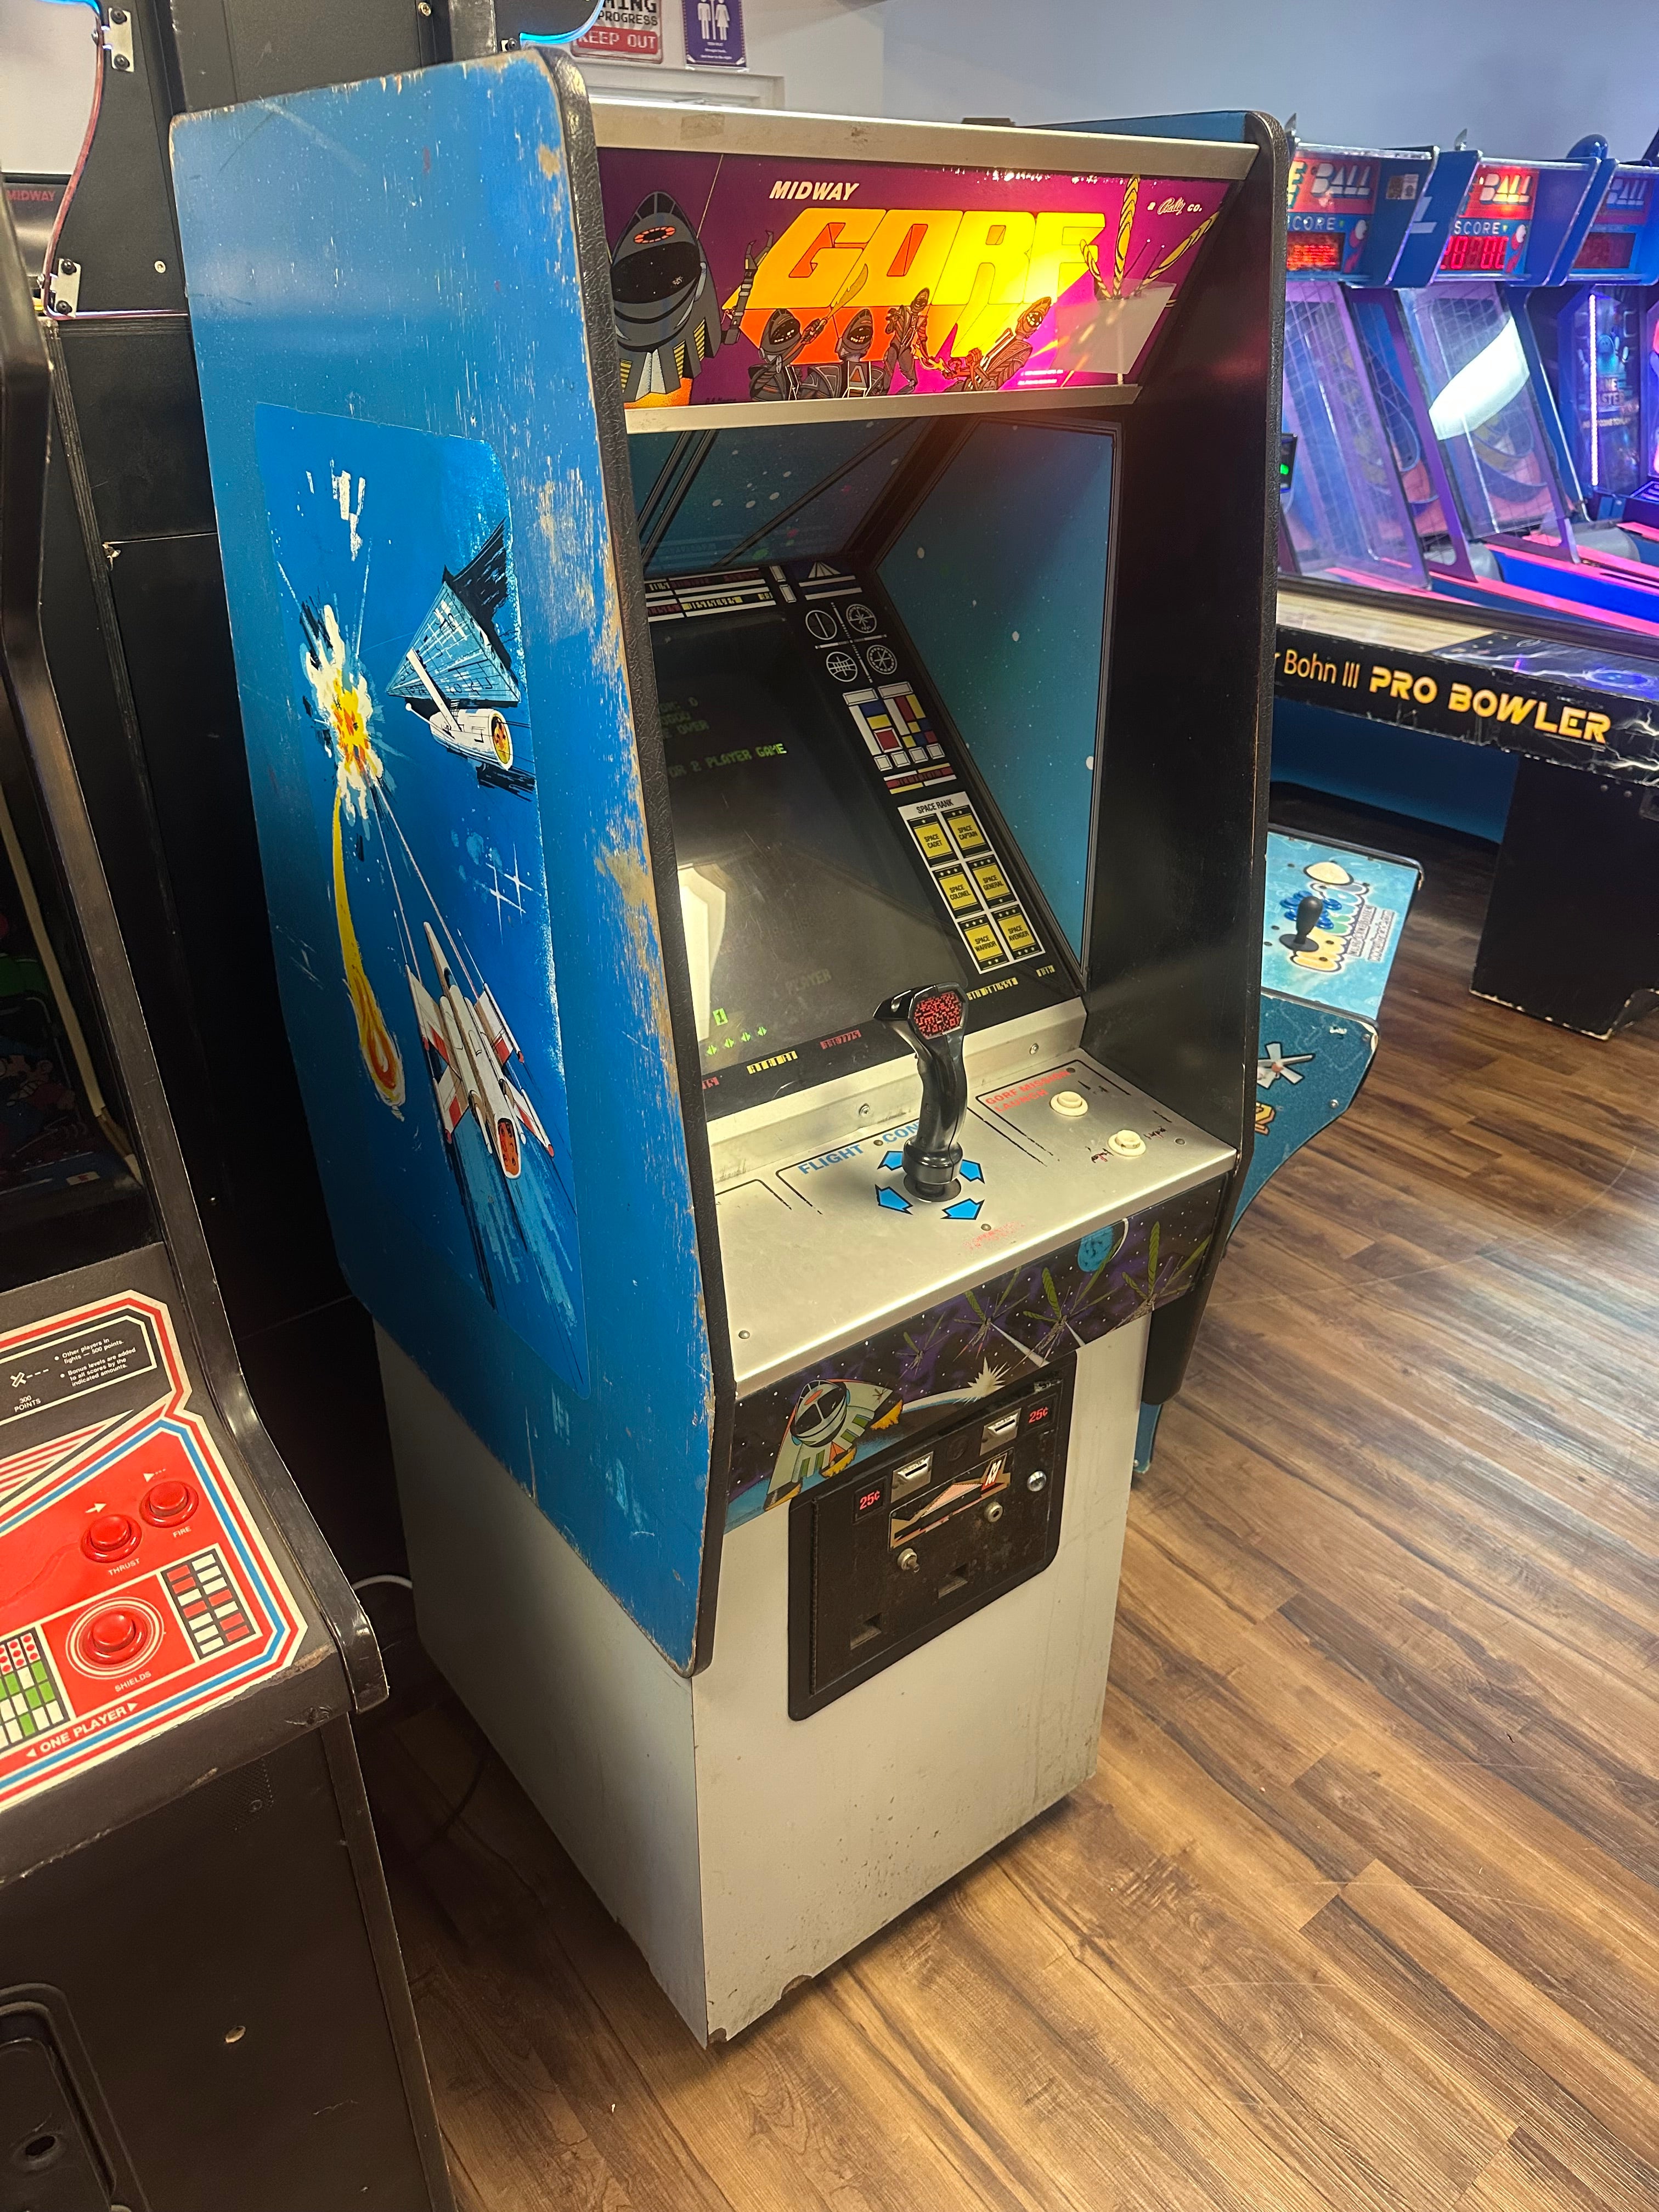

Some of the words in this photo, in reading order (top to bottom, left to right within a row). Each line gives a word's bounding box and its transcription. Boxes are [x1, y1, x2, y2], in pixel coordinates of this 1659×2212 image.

[598, 10, 658, 26] PROGRESS
[627, 34, 656, 49] OUT
[1311, 162, 1371, 196] BALL
[7, 190, 55, 201] MIDWAY
[769, 180, 860, 201] MIDWAY
[1479, 173, 1532, 204] BALL
[1606, 178, 1648, 206] BALL
[1157, 196, 1186, 216] Bally
[1288, 216, 1336, 231] CORE
[1454, 220, 1502, 235] SCORE
[723, 207, 1105, 314] GORF
[1283, 648, 1338, 685] Bohn
[1369, 665, 1438, 704] PRO
[1448, 682, 1611, 745] BOWLER
[705, 749, 753, 768] PLAYER
[755, 743, 787, 758] GAME
[916, 803, 937, 814] SPACE
[935, 798, 955, 810] RANK
[957, 825, 973, 834] SPACE
[958, 831, 978, 840] CAPTAIN
[924, 833, 940, 843] SPACE
[927, 839, 943, 849] CADET
[983, 874, 998, 884] SPACE
[983, 881, 1004, 891] GENERAL
[949, 884, 964, 894] SPACE
[949, 890, 971, 901] COLONEL
[1007, 925, 1023, 934] SPACE
[1008, 930, 1030, 942] AVENGER
[974, 935, 991, 945] SPACE
[974, 940, 998, 952] WARRIOR
[985, 1088, 1018, 1105] GORF
[1018, 1069, 1071, 1093] MISSION
[994, 1088, 1049, 1113] LAUNCH
[797, 1144, 864, 1175] FLIGHT
[882, 1122, 920, 1143] CON
[62, 1349, 80, 1358] Other
[80, 1341, 103, 1352] players
[64, 1355, 82, 1364] fights
[104, 1340, 124, 1351] points.
[67, 1365, 87, 1376] Bonus
[88, 1359, 106, 1368] levels
[117, 1347, 136, 1358] added
[71, 1373, 99, 1387] indicated
[100, 1363, 128, 1376] amounts.
[87, 1365, 107, 1375] scores
[14, 1398, 41, 1412] POINTS
[19, 1395, 32, 1403] 300
[1028, 1406, 1049, 1424] 25¢
[859, 1489, 881, 1510] 25¢
[172, 1526, 192, 1538] FIRE
[108, 1558, 141, 1576] THRUST
[114, 1671, 152, 1692] SHIELDS
[40, 1733, 71, 1753] ONE
[73, 1707, 128, 1739] PLAYER
